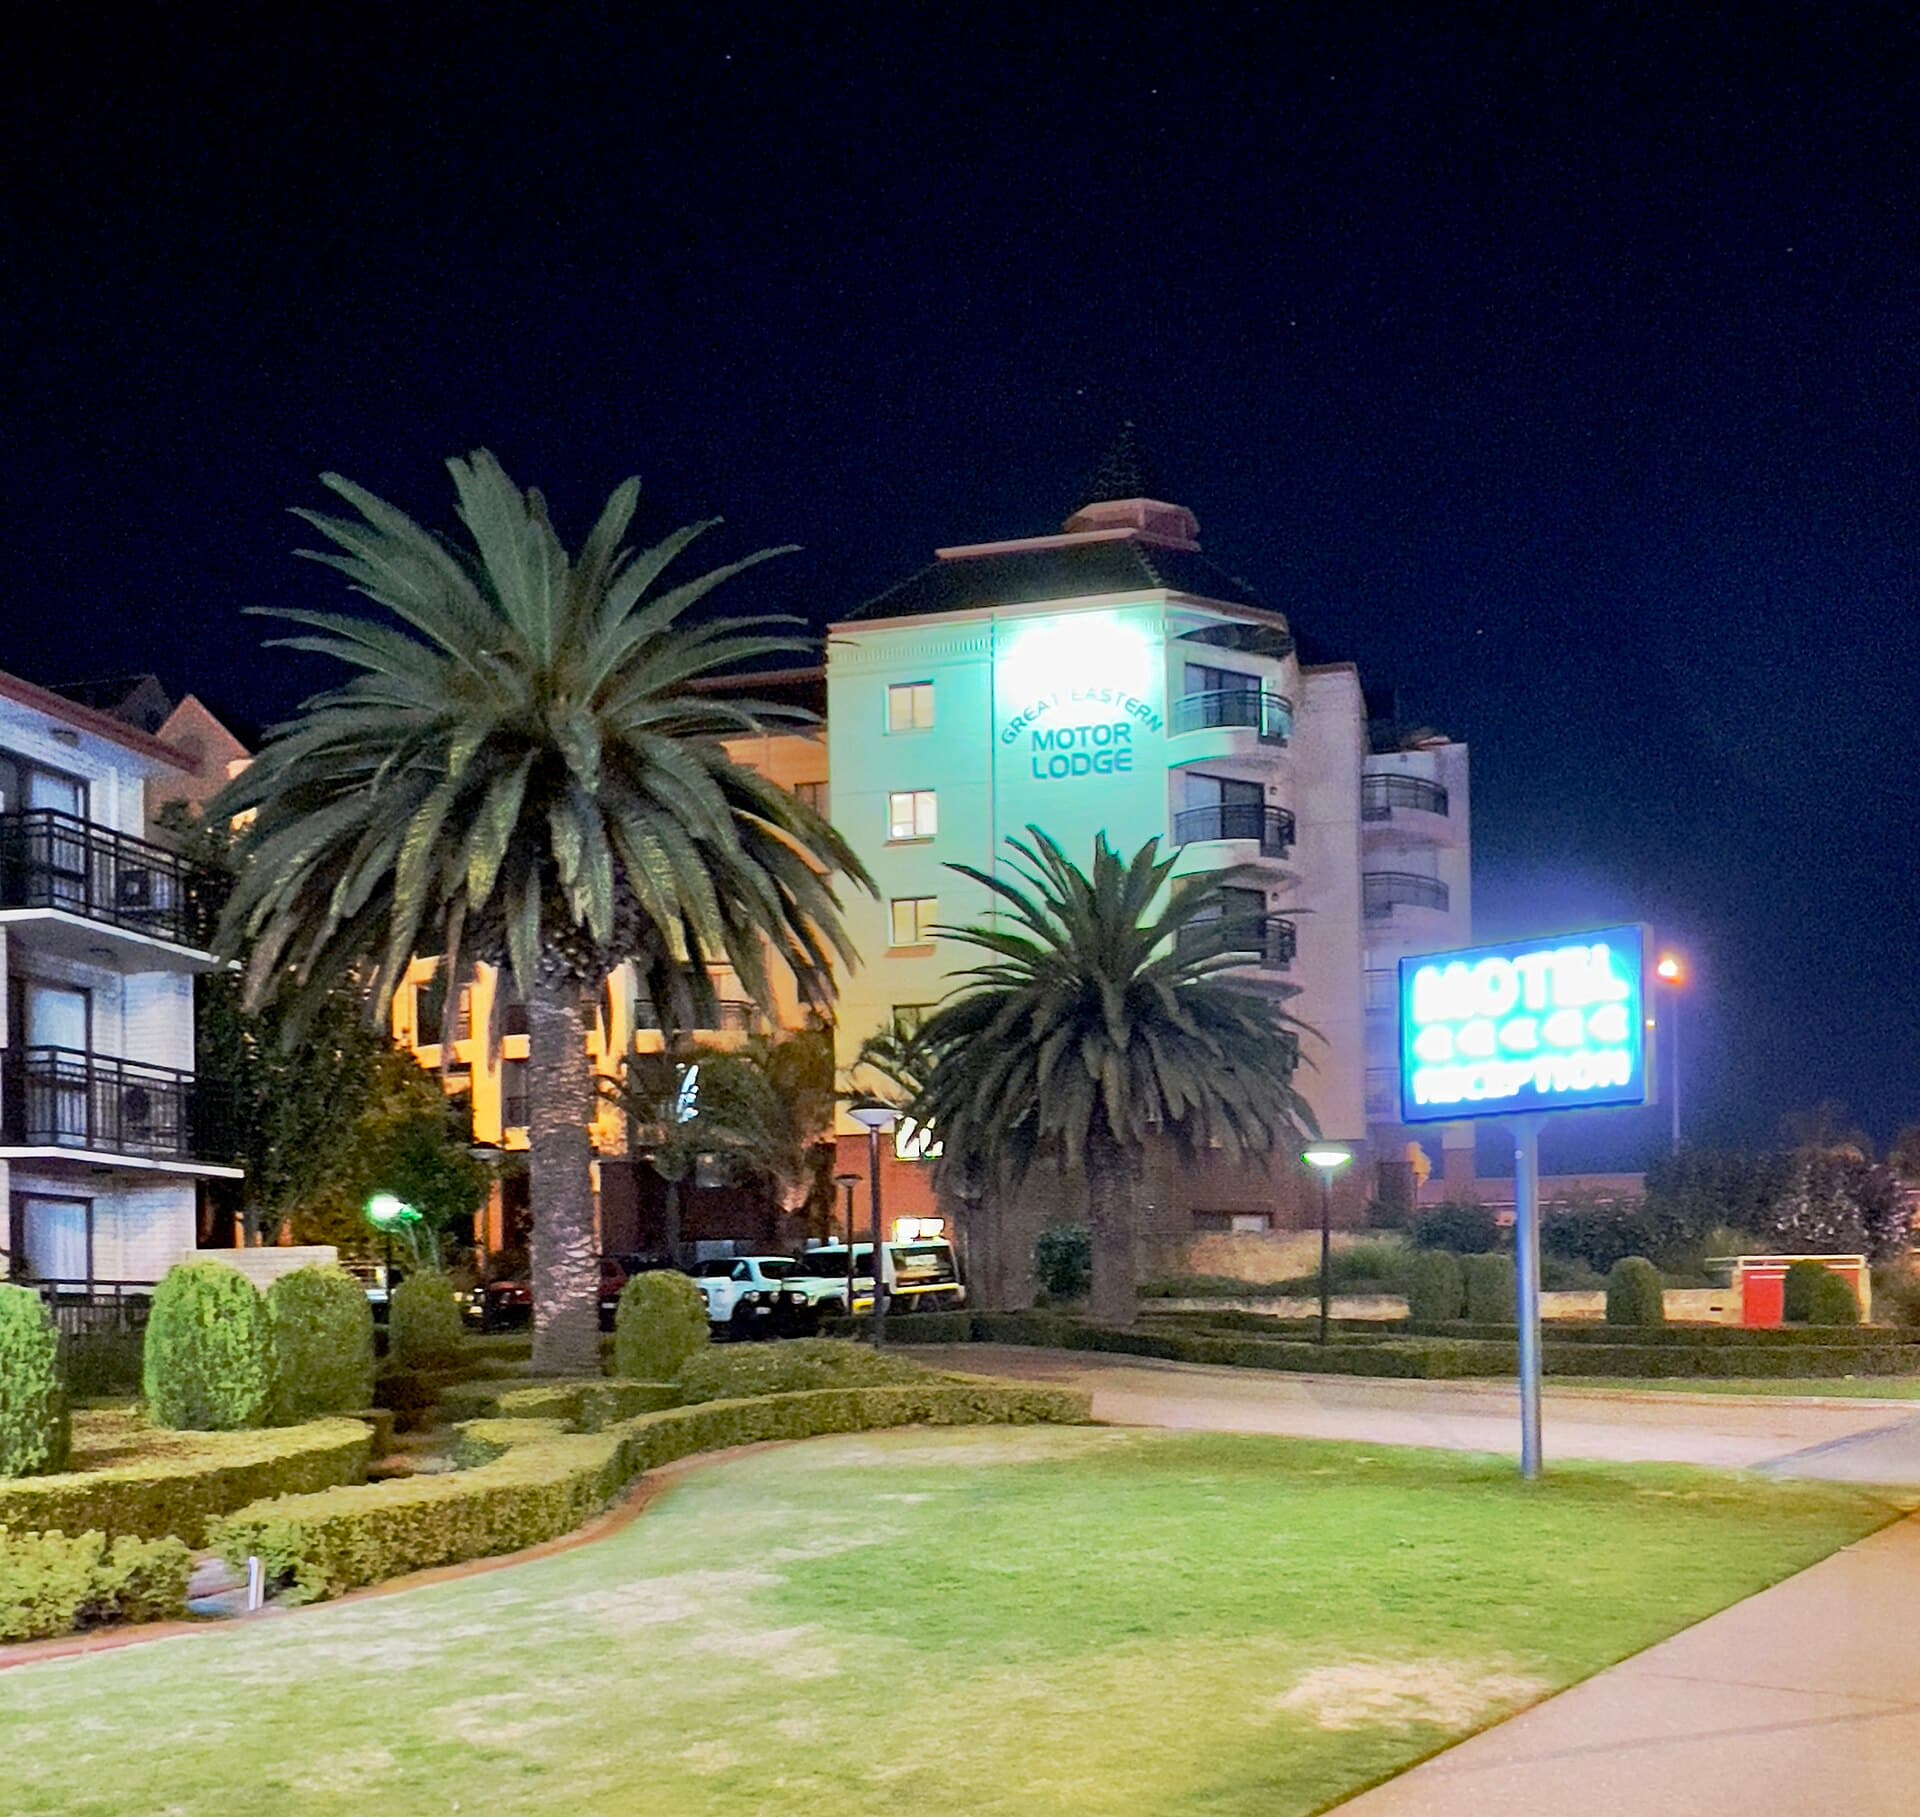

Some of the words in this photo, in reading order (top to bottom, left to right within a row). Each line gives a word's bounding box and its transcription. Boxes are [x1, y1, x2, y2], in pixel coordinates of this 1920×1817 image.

[1001, 692, 1059, 744] GREAT
[1071, 688, 1164, 732] EASTERN
[1032, 722, 1132, 751] MOTOR
[1032, 748, 1133, 779] LODGE
[1413, 1049, 1630, 1104] RPTION
